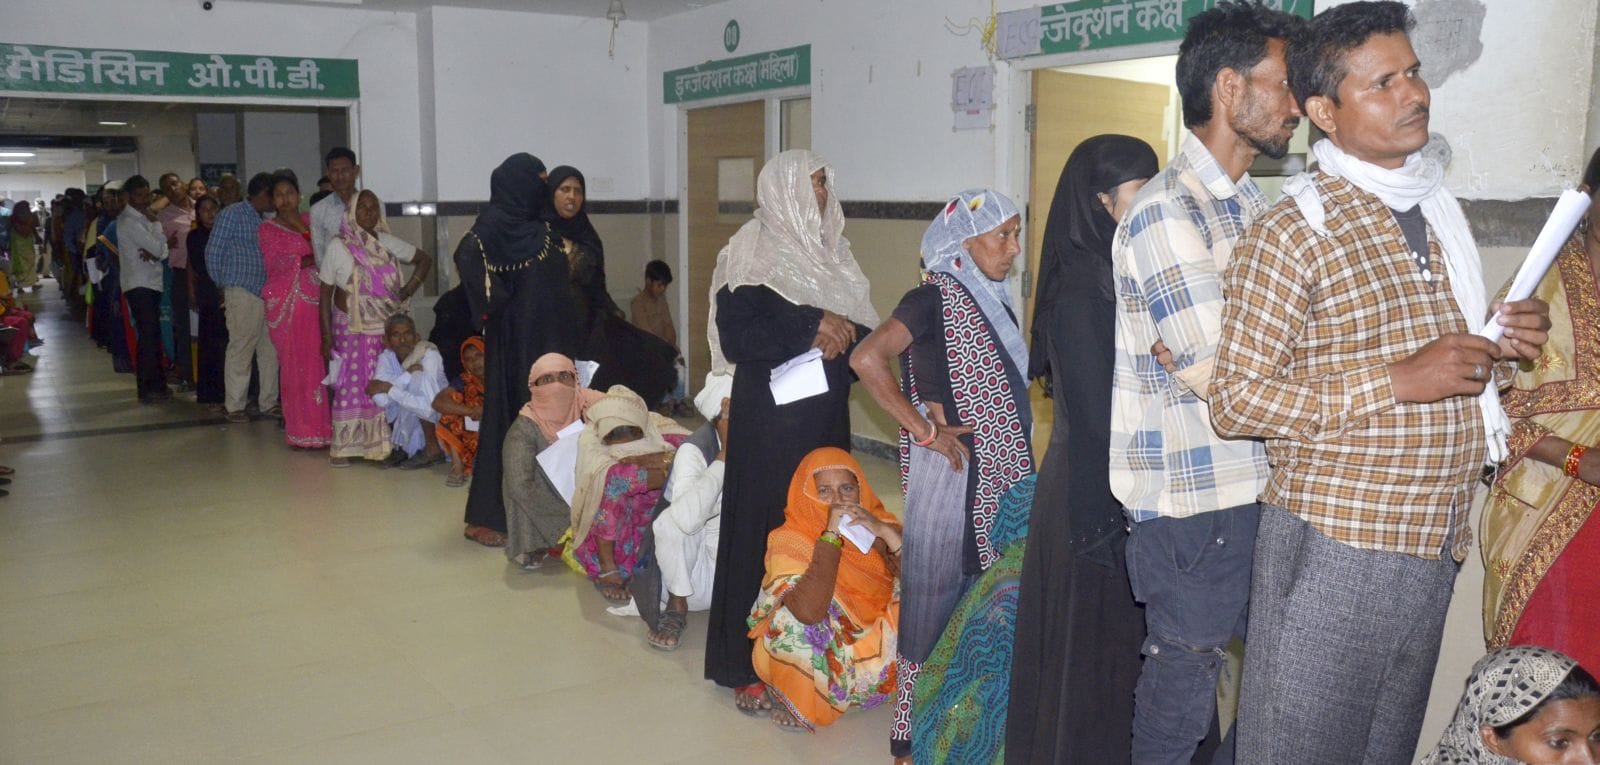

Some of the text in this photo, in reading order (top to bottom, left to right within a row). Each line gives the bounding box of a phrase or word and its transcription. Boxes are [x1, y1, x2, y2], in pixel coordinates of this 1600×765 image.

[1134, 0, 1183, 32] कक्ष
[6, 46, 325, 90] मेडिसिन ओ.पी.डी.
[732, 62, 757, 88] कक्ष
[757, 50, 800, 84] (महिला)
